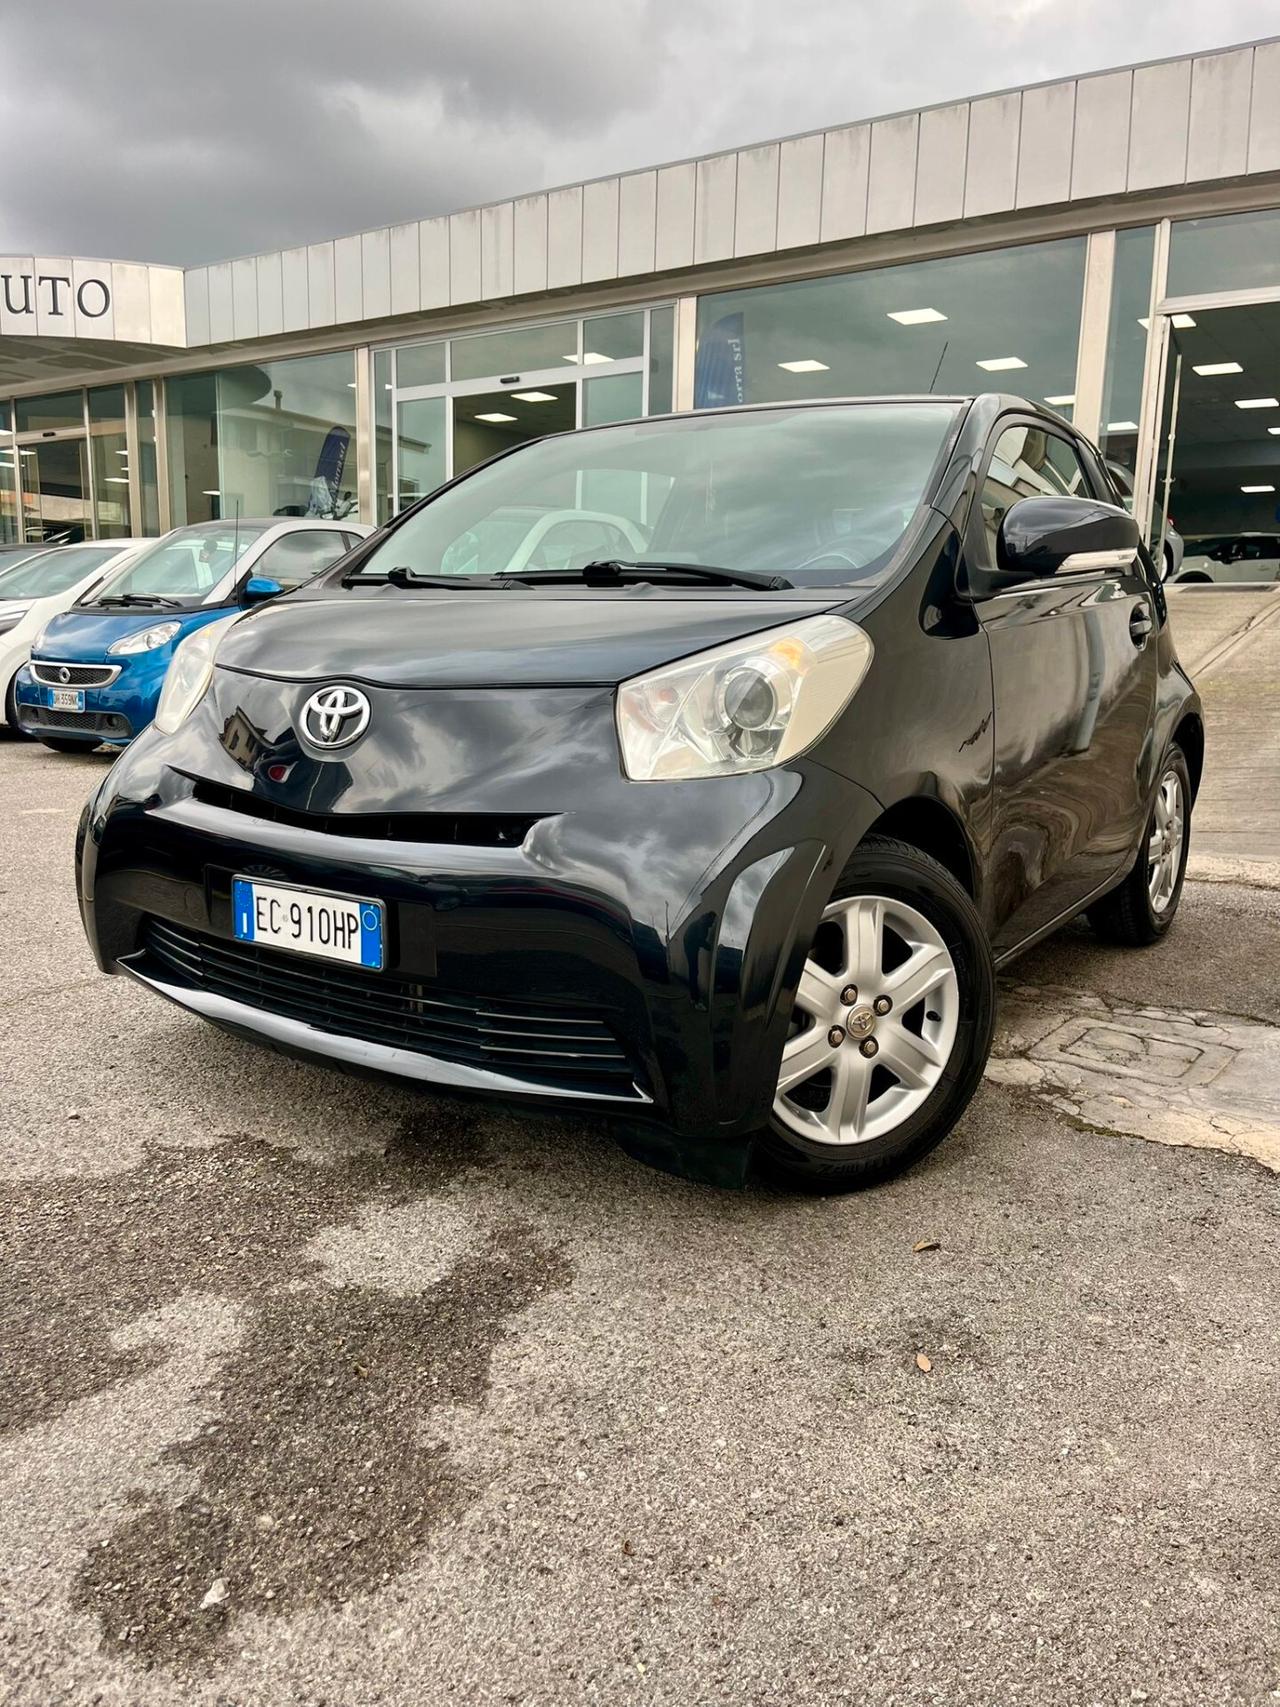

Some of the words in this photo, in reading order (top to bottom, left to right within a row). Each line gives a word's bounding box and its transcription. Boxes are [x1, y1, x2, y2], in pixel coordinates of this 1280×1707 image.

[1, 274, 111, 318] UTO
[256, 896, 281, 934] EC
[290, 903, 359, 949] 910HP
